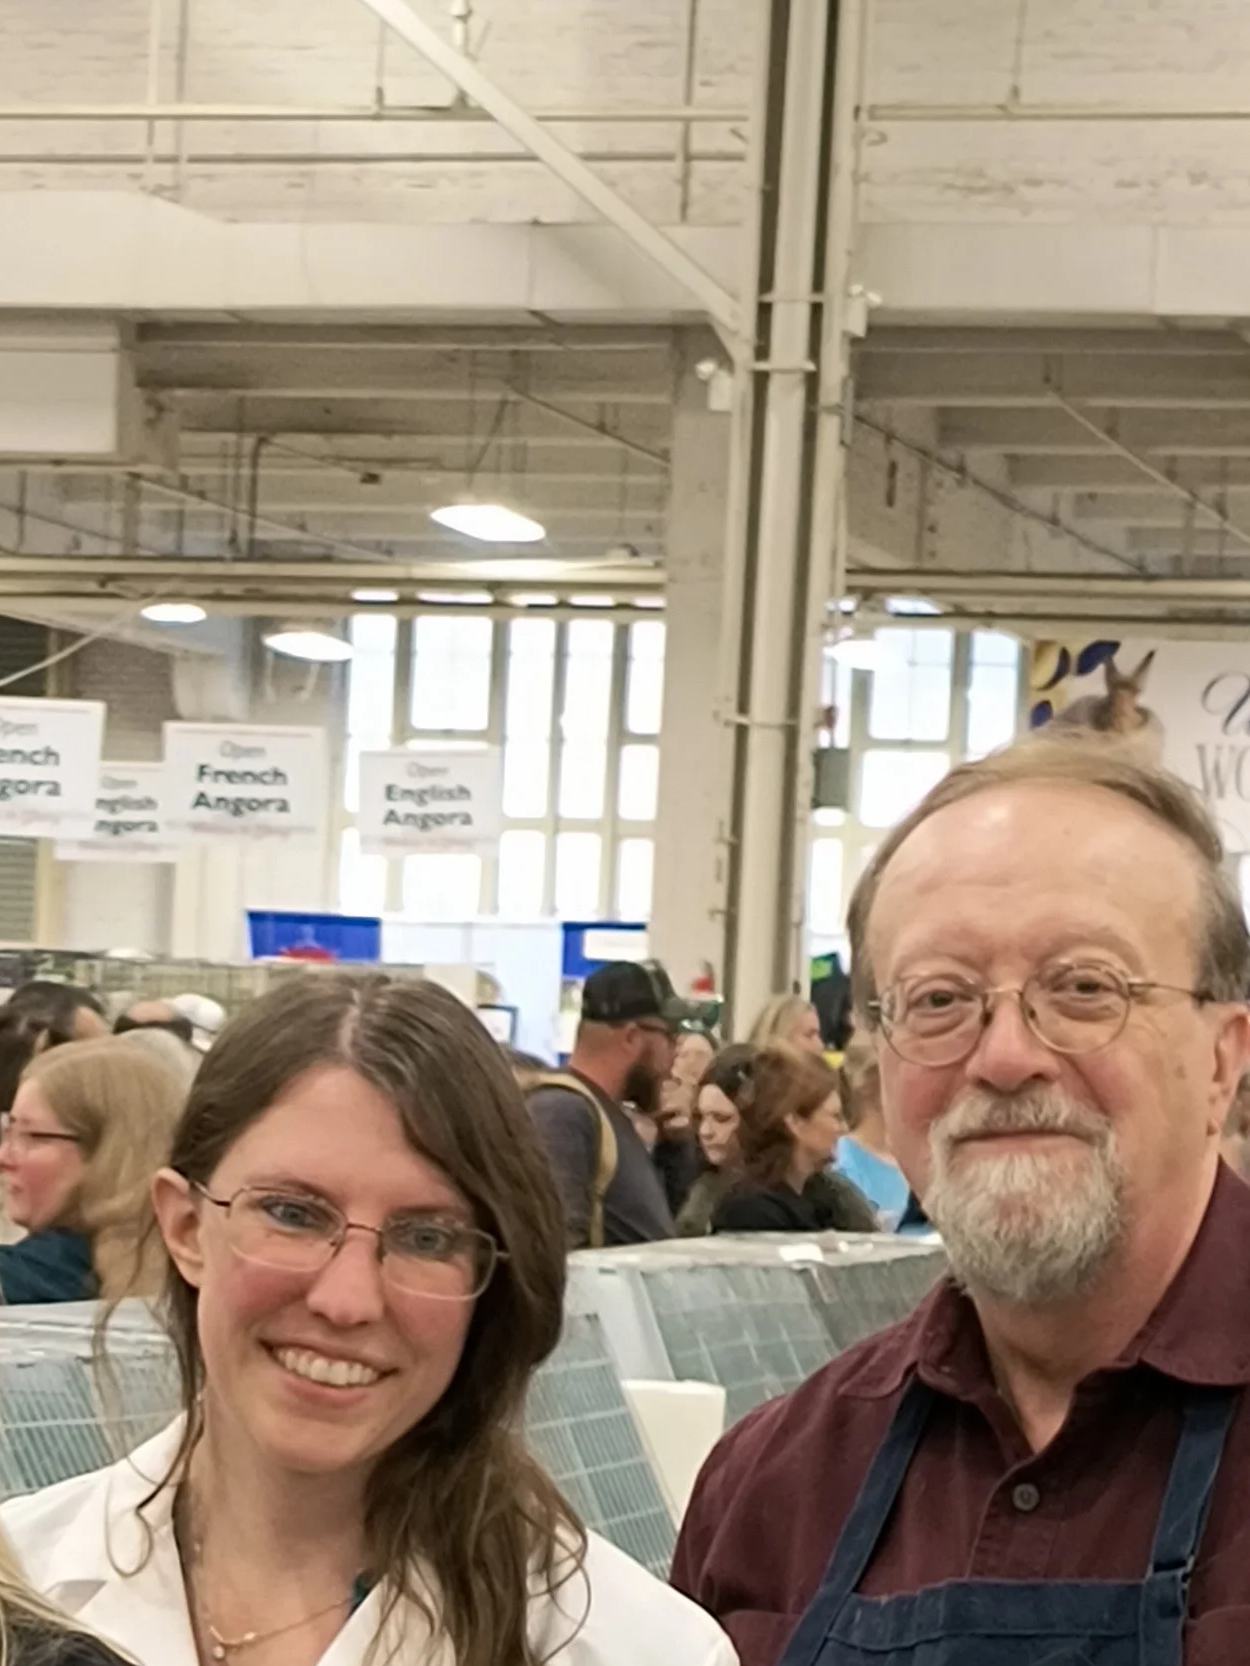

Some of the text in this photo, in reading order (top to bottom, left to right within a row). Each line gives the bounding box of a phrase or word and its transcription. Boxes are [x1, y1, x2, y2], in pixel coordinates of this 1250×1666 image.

[219, 739, 267, 761] Open
[196, 763, 287, 786] French
[95, 795, 158, 814] nglish
[192, 791, 291, 817] Angora
[384, 784, 472, 807] English
[94, 820, 159, 835] ngora
[384, 809, 473, 832] Angora
